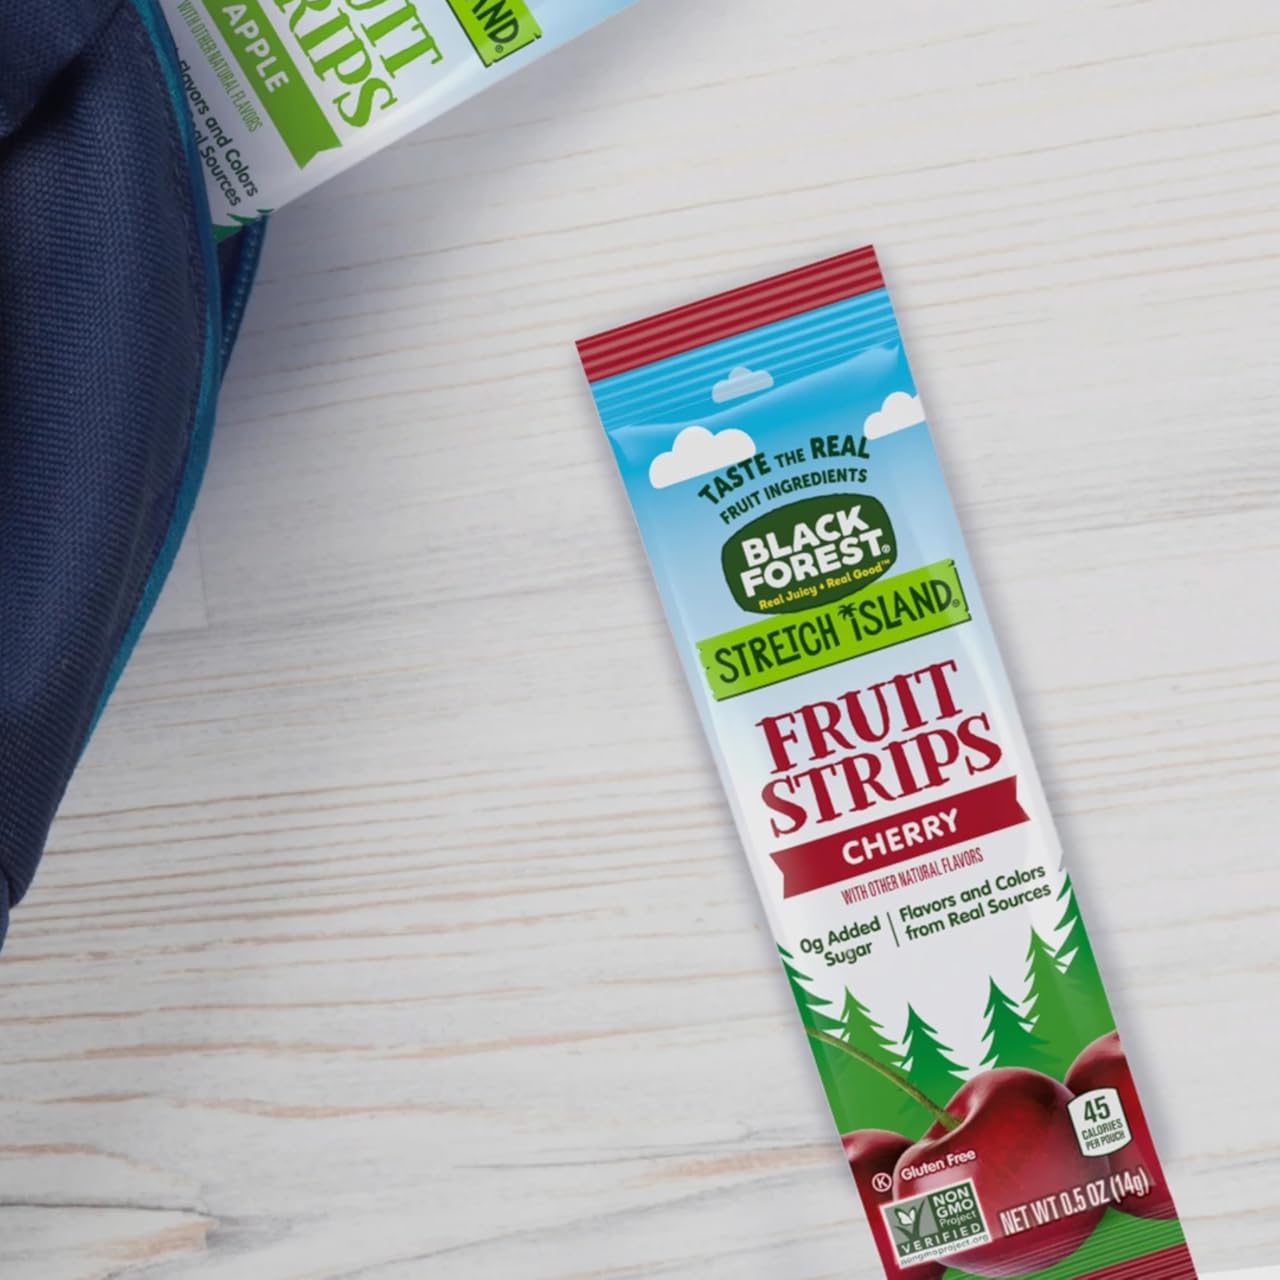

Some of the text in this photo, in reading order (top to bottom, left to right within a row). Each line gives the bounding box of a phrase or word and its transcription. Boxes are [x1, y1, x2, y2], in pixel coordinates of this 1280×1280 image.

[220, 3, 290, 93] APPLE
[190, 22, 218, 55] OTHER
[206, 50, 241, 94] NATURAL
[229, 89, 263, 133] FLAVORS
[199, 145, 241, 207] Sources
[203, 116, 258, 197] and Colors
[698, 433, 869, 504] TASTE THE REAL
[719, 468, 867, 524] FRUIT INGREDIENTS
[740, 504, 869, 567] BLACK
[758, 594, 784, 610] Real
[784, 584, 817, 602] Juicy
[825, 572, 851, 588] Real
[714, 612, 840, 682] STRETCH
[755, 659, 963, 774] FRUIT
[762, 711, 1001, 837] STRIPS
[841, 807, 957, 865] CHERRY
[841, 846, 984, 905] WITH OTHER NATURAL FLAVORS
[898, 866, 1045, 922] Flavors and Colors
[830, 915, 881, 946] Added
[904, 883, 1051, 942] from Real Sources
[824, 940, 871, 967] Sugar
[1080, 1095, 1111, 1124] 45
[1081, 1118, 1123, 1140] CALORIES
[900, 1149, 976, 1181] Gluten Free
[1085, 1129, 1125, 1150] PER POUCH
[932, 1186, 969, 1207] NON
[935, 1197, 974, 1219] GMO
[939, 1209, 976, 1227] Project
[998, 1166, 1151, 1235] NET WT 0.5 OZ (14g)
[901, 1221, 981, 1254] VERIFIED
